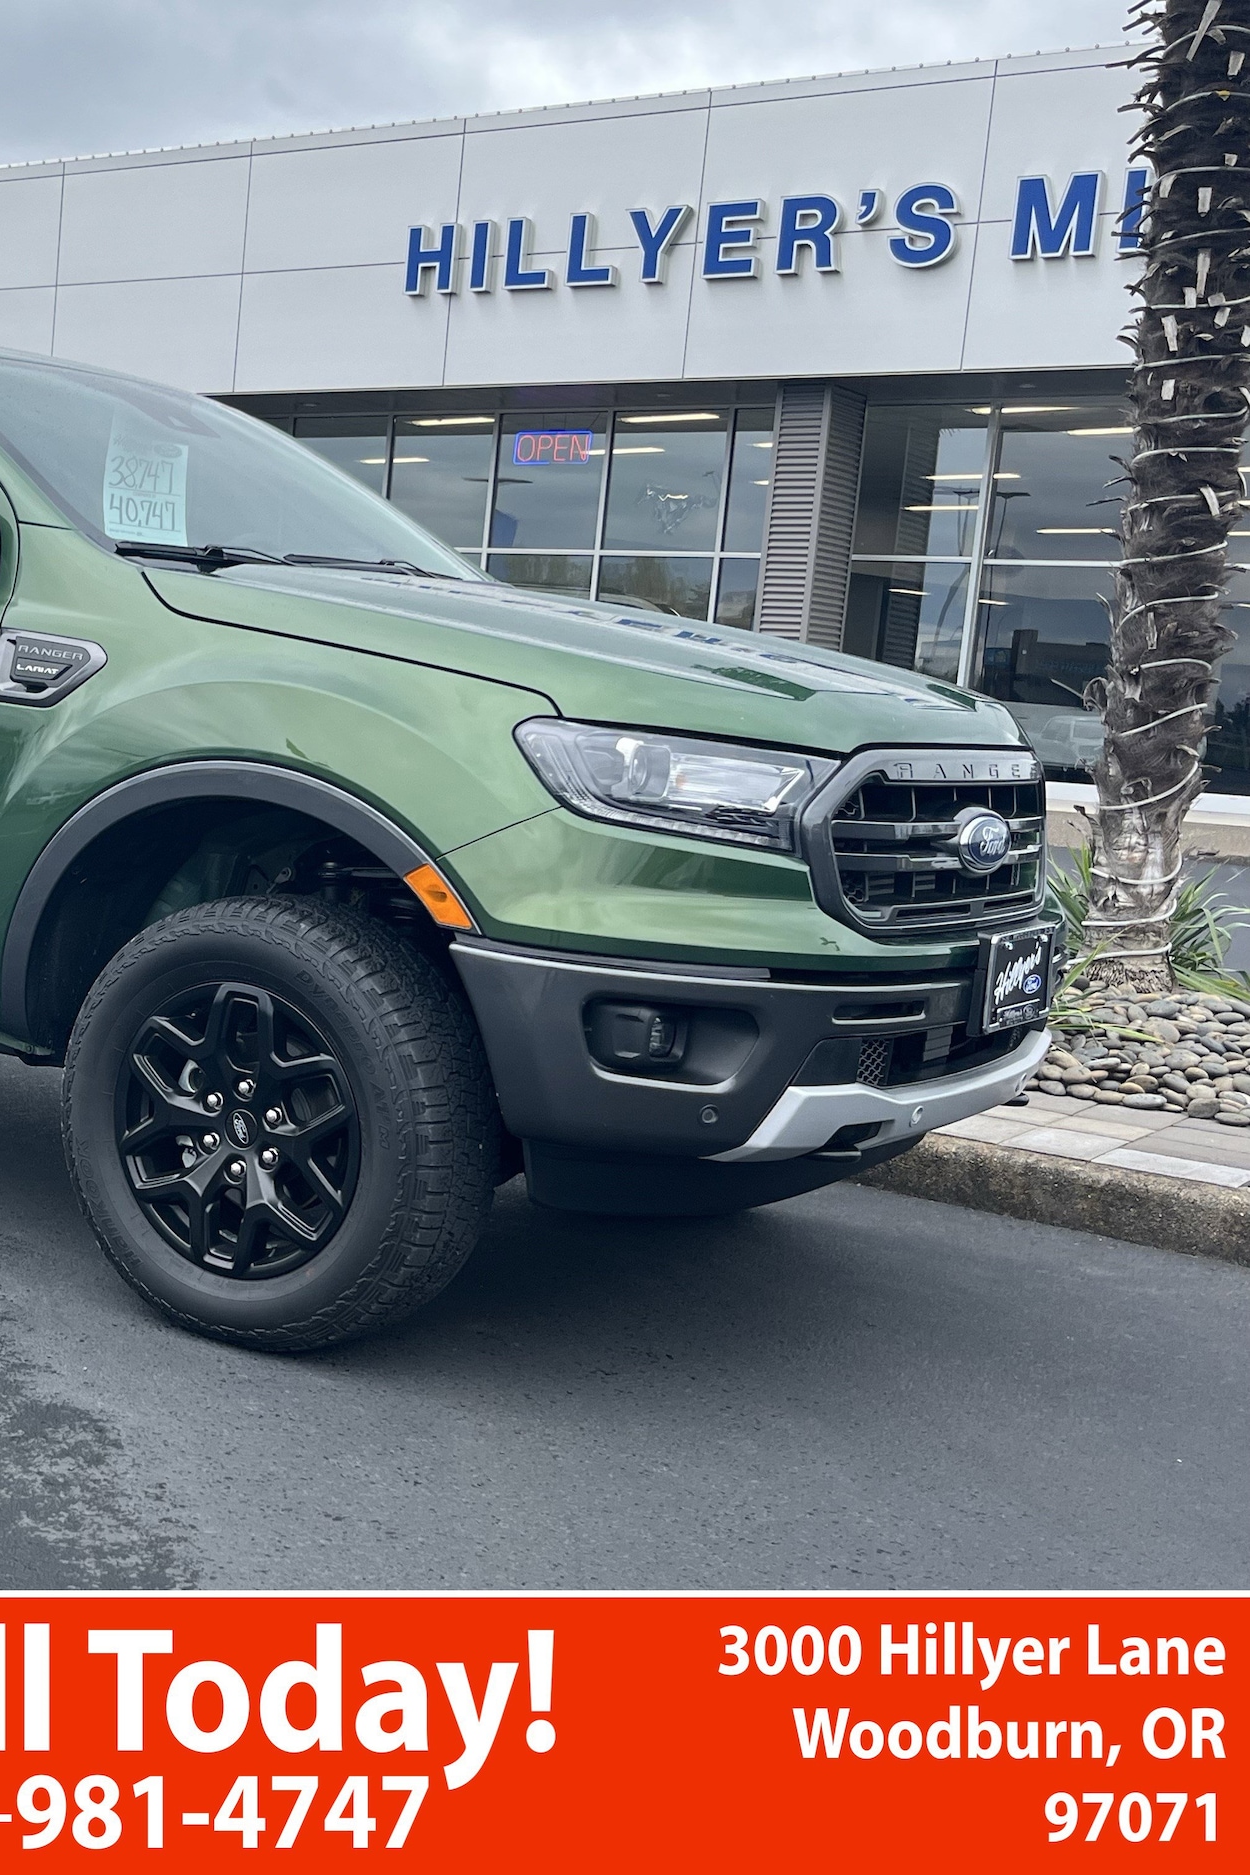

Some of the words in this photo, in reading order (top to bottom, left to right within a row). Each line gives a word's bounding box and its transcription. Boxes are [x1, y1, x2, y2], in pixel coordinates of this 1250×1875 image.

[403, 182, 958, 296] HILLYER'S
[1009, 166, 1152, 261] MI
[517, 434, 590, 462] OPEN
[109, 493, 175, 532] 40,747
[18, 644, 84, 661] RANGER
[16, 663, 60, 676] LARIAT
[979, 826, 1006, 856] Ford
